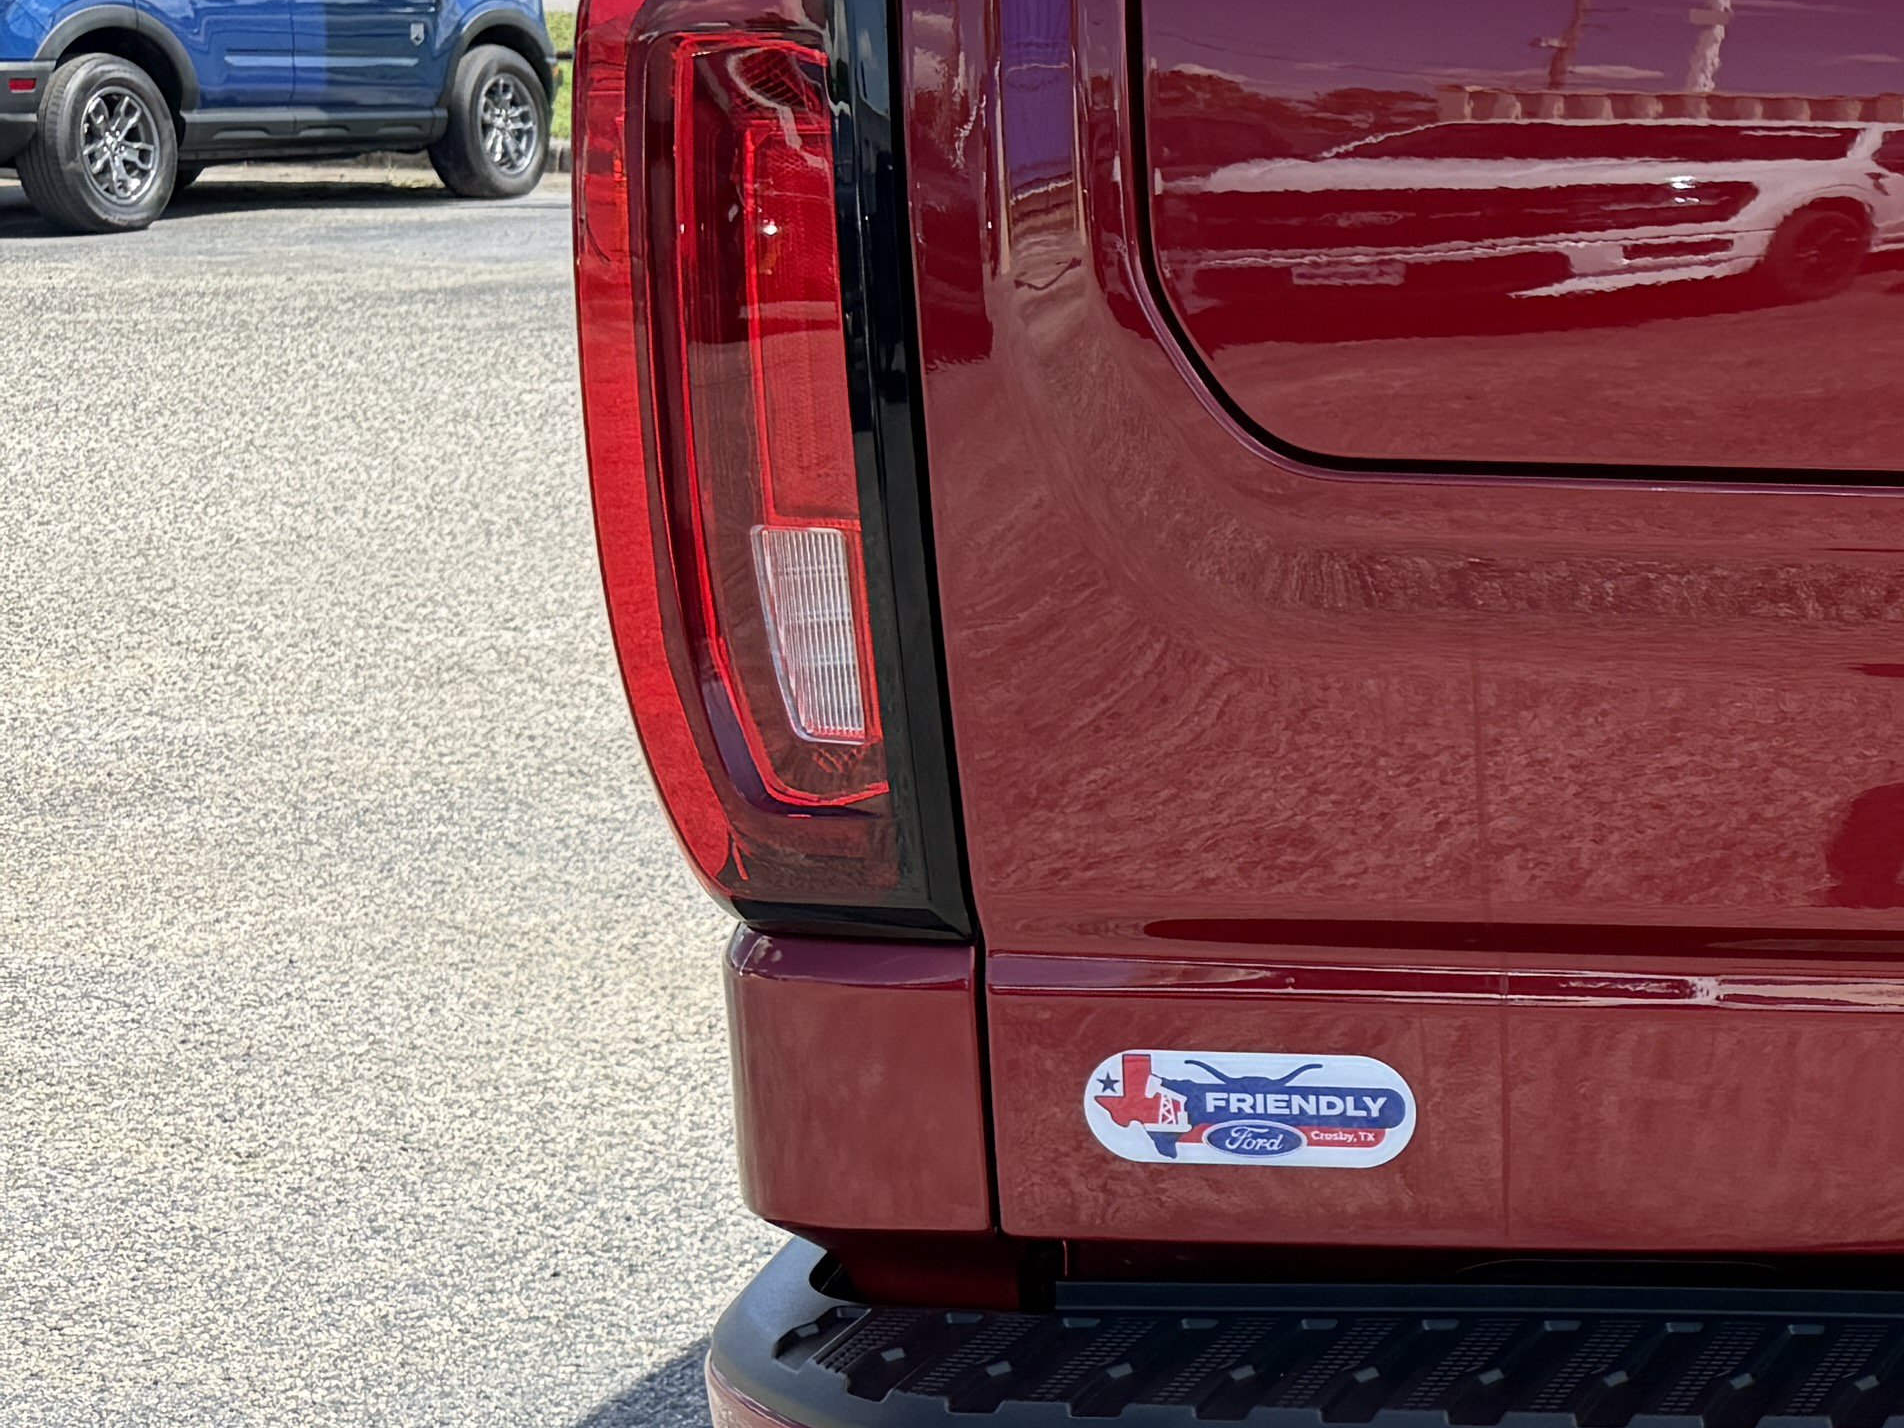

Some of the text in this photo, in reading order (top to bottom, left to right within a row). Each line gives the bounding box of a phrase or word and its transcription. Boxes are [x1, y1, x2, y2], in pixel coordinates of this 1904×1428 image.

[1205, 1092, 1387, 1117] FRIENDLY
[1225, 1125, 1284, 1152] Ford
[1311, 1130, 1376, 1144] Crosby, TX
